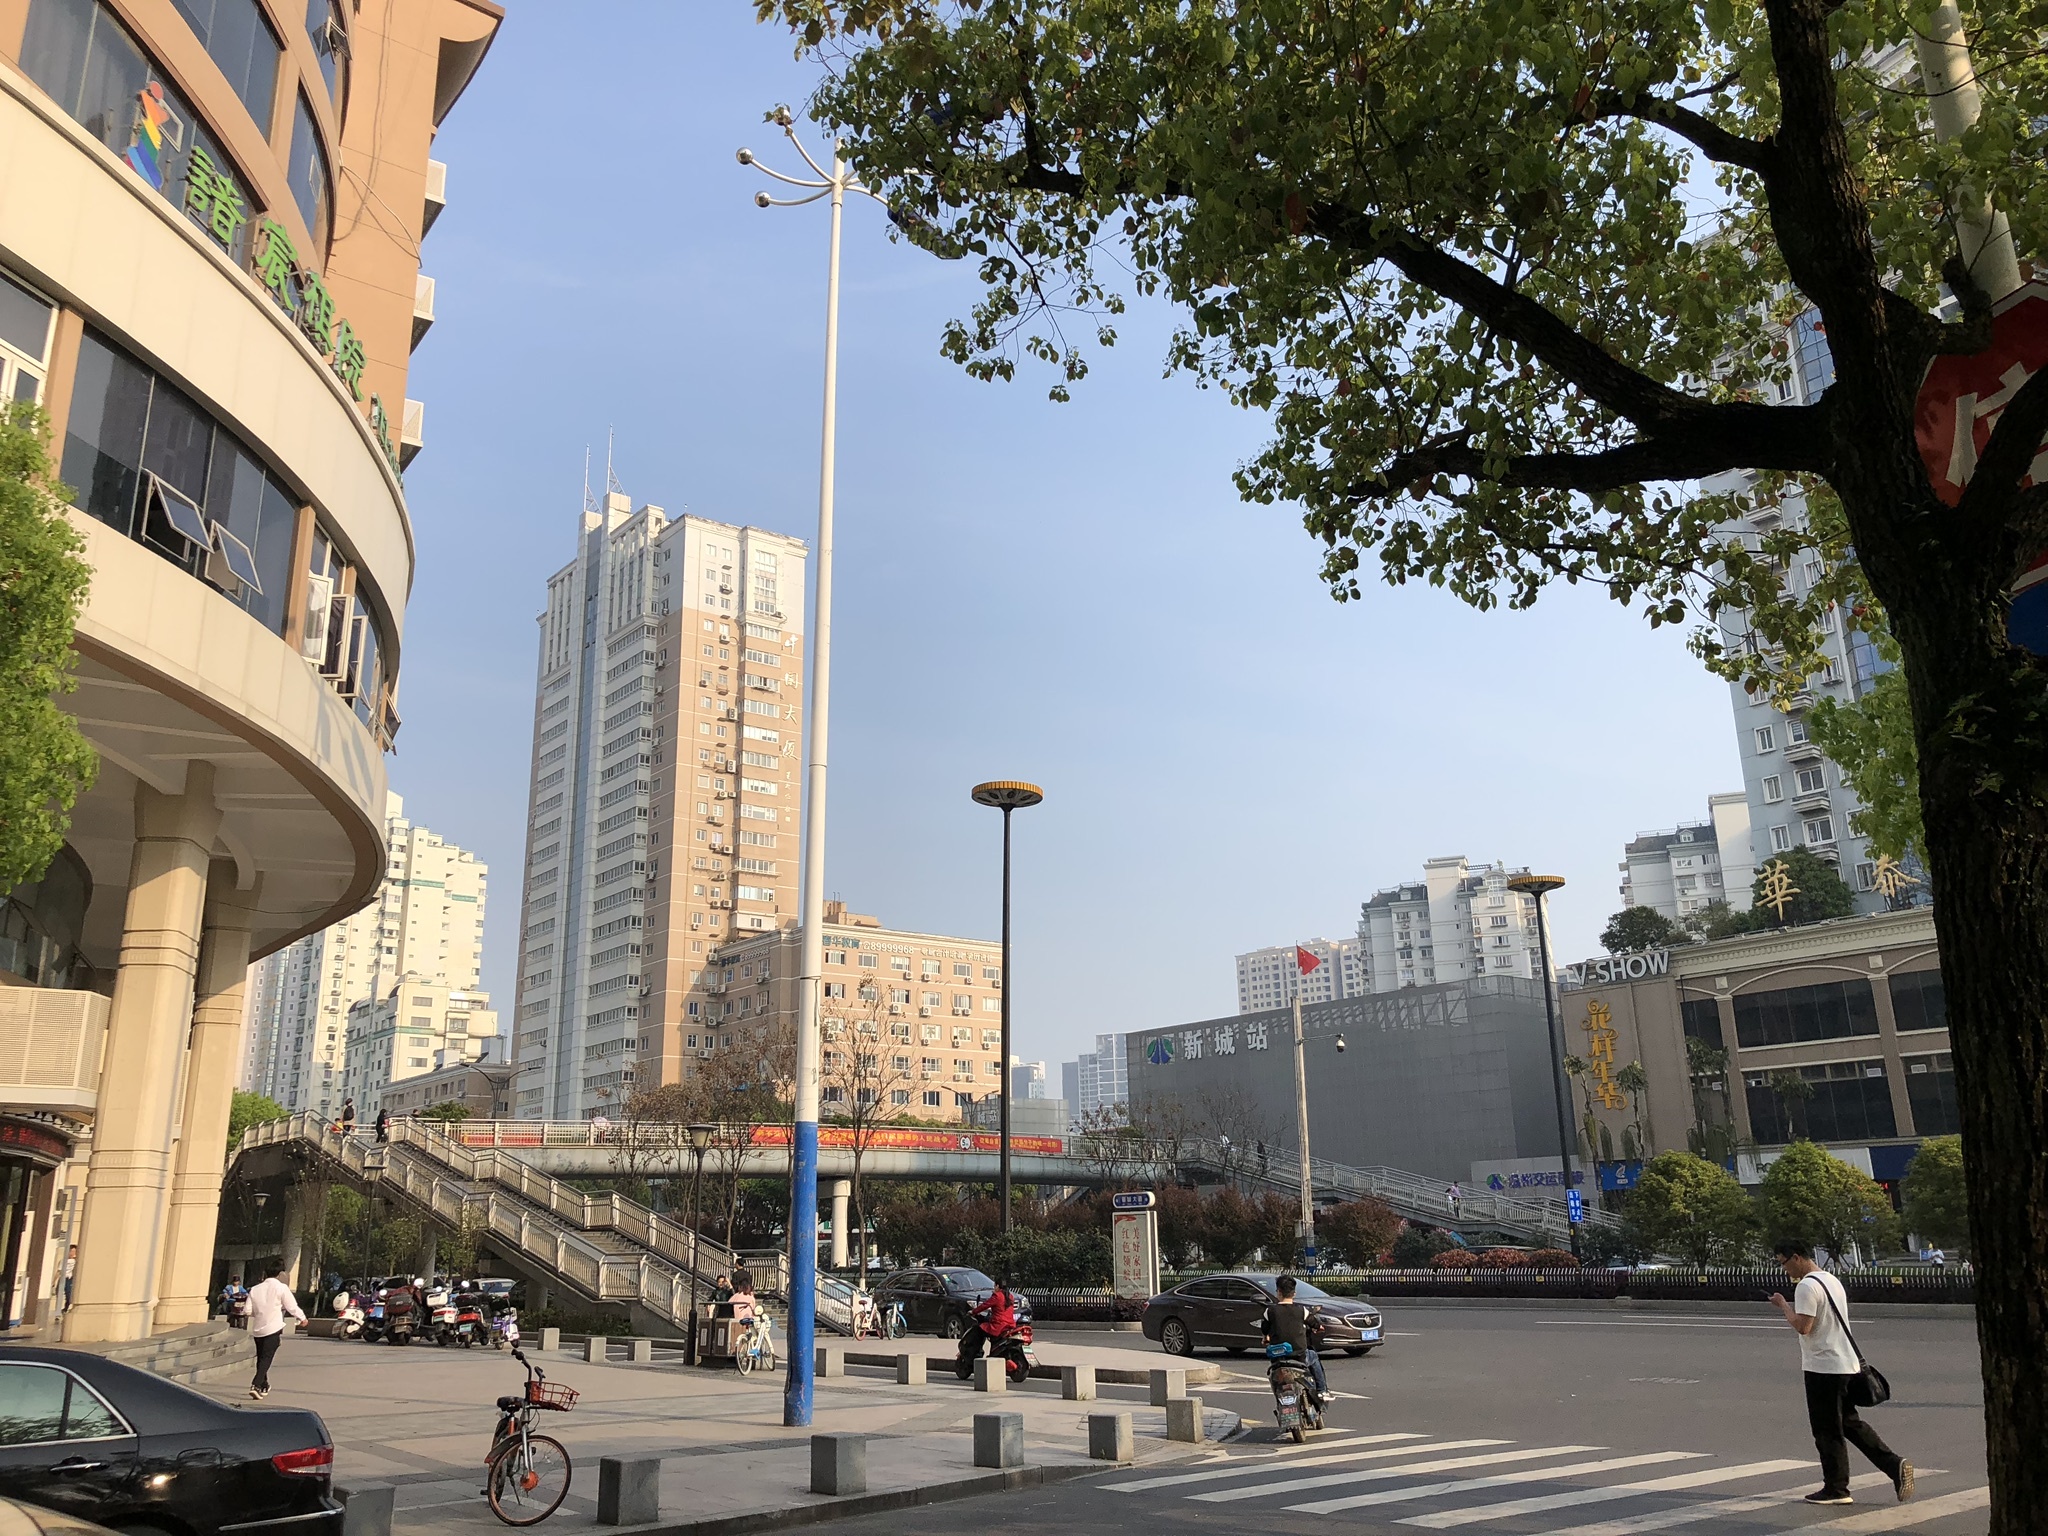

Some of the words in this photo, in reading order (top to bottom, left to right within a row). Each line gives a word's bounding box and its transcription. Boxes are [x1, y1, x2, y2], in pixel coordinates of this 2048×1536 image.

[870, 941, 914, 954] 89999968
[1572, 951, 1670, 986] V-SHOW
[1184, 1022, 1268, 1061] 新城站
[1580, 998, 1628, 1111] 花样年华
